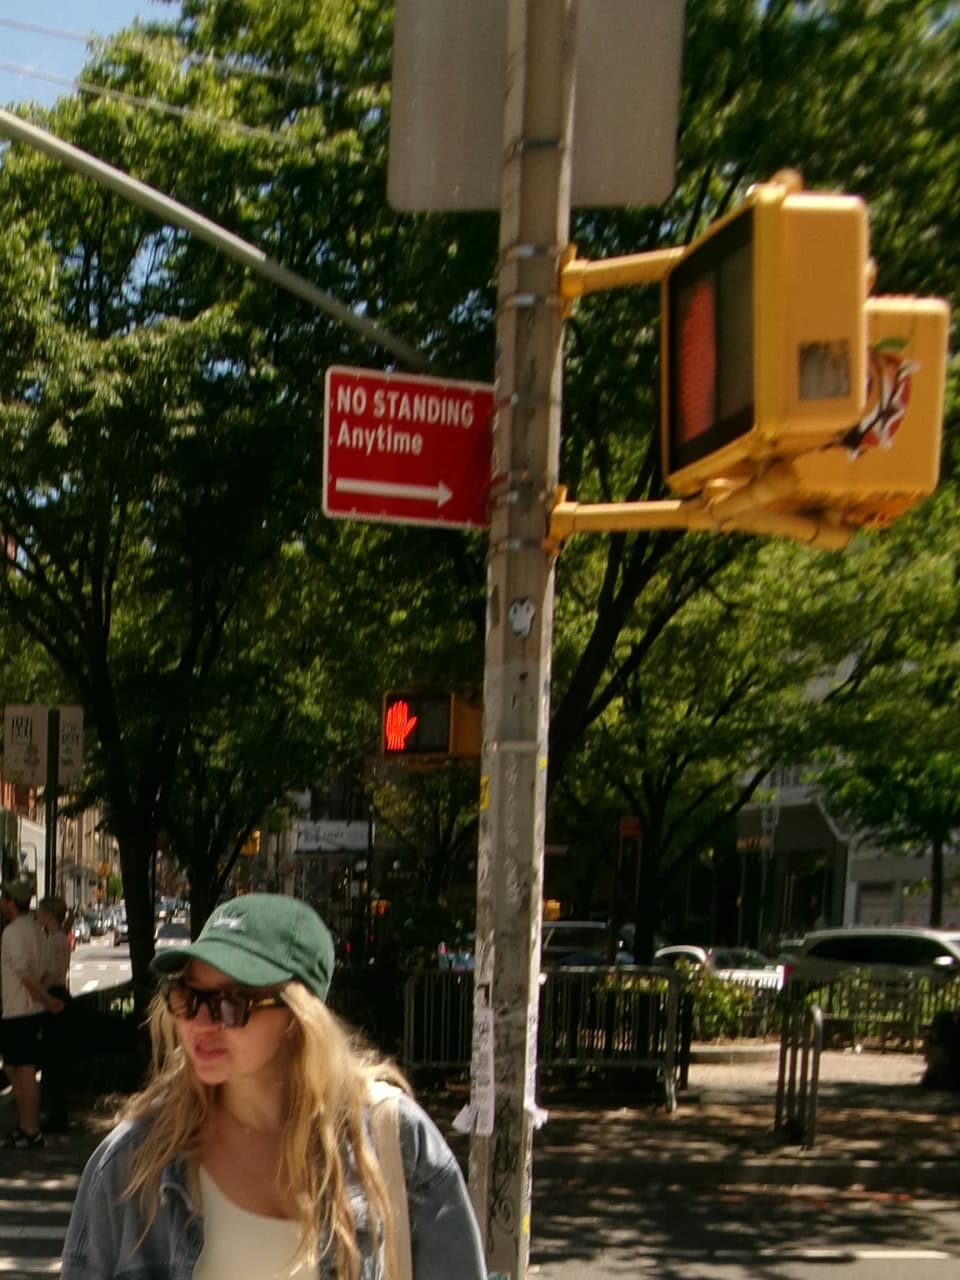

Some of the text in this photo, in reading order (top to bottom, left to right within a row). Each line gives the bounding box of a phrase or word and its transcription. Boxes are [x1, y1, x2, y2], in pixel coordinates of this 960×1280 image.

[337, 385, 474, 428] NO STANDING
[337, 420, 423, 456] Anytime
